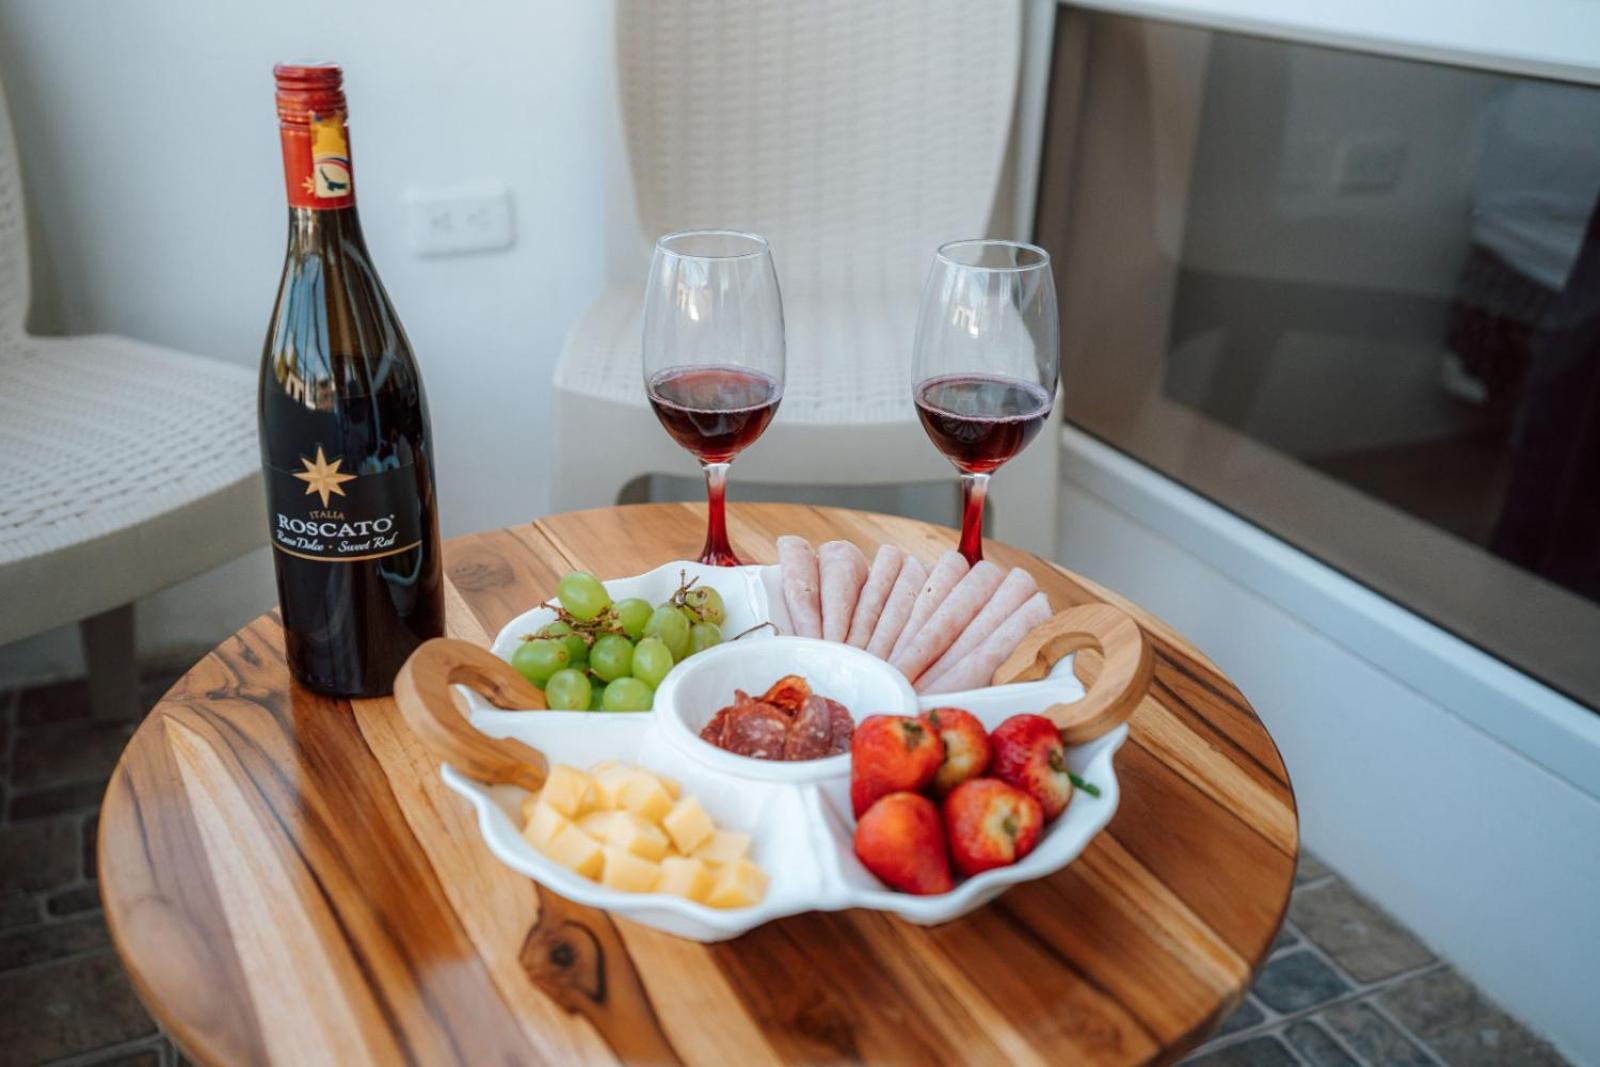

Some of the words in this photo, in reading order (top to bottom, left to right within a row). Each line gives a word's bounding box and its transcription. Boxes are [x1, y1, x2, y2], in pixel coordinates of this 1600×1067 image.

[277, 513, 393, 537] ROSCATO
[309, 511, 344, 520] ITALIA
[296, 537, 325, 551] Dolce
[337, 540, 370, 552] Sweet
[373, 531, 398, 548] Red
